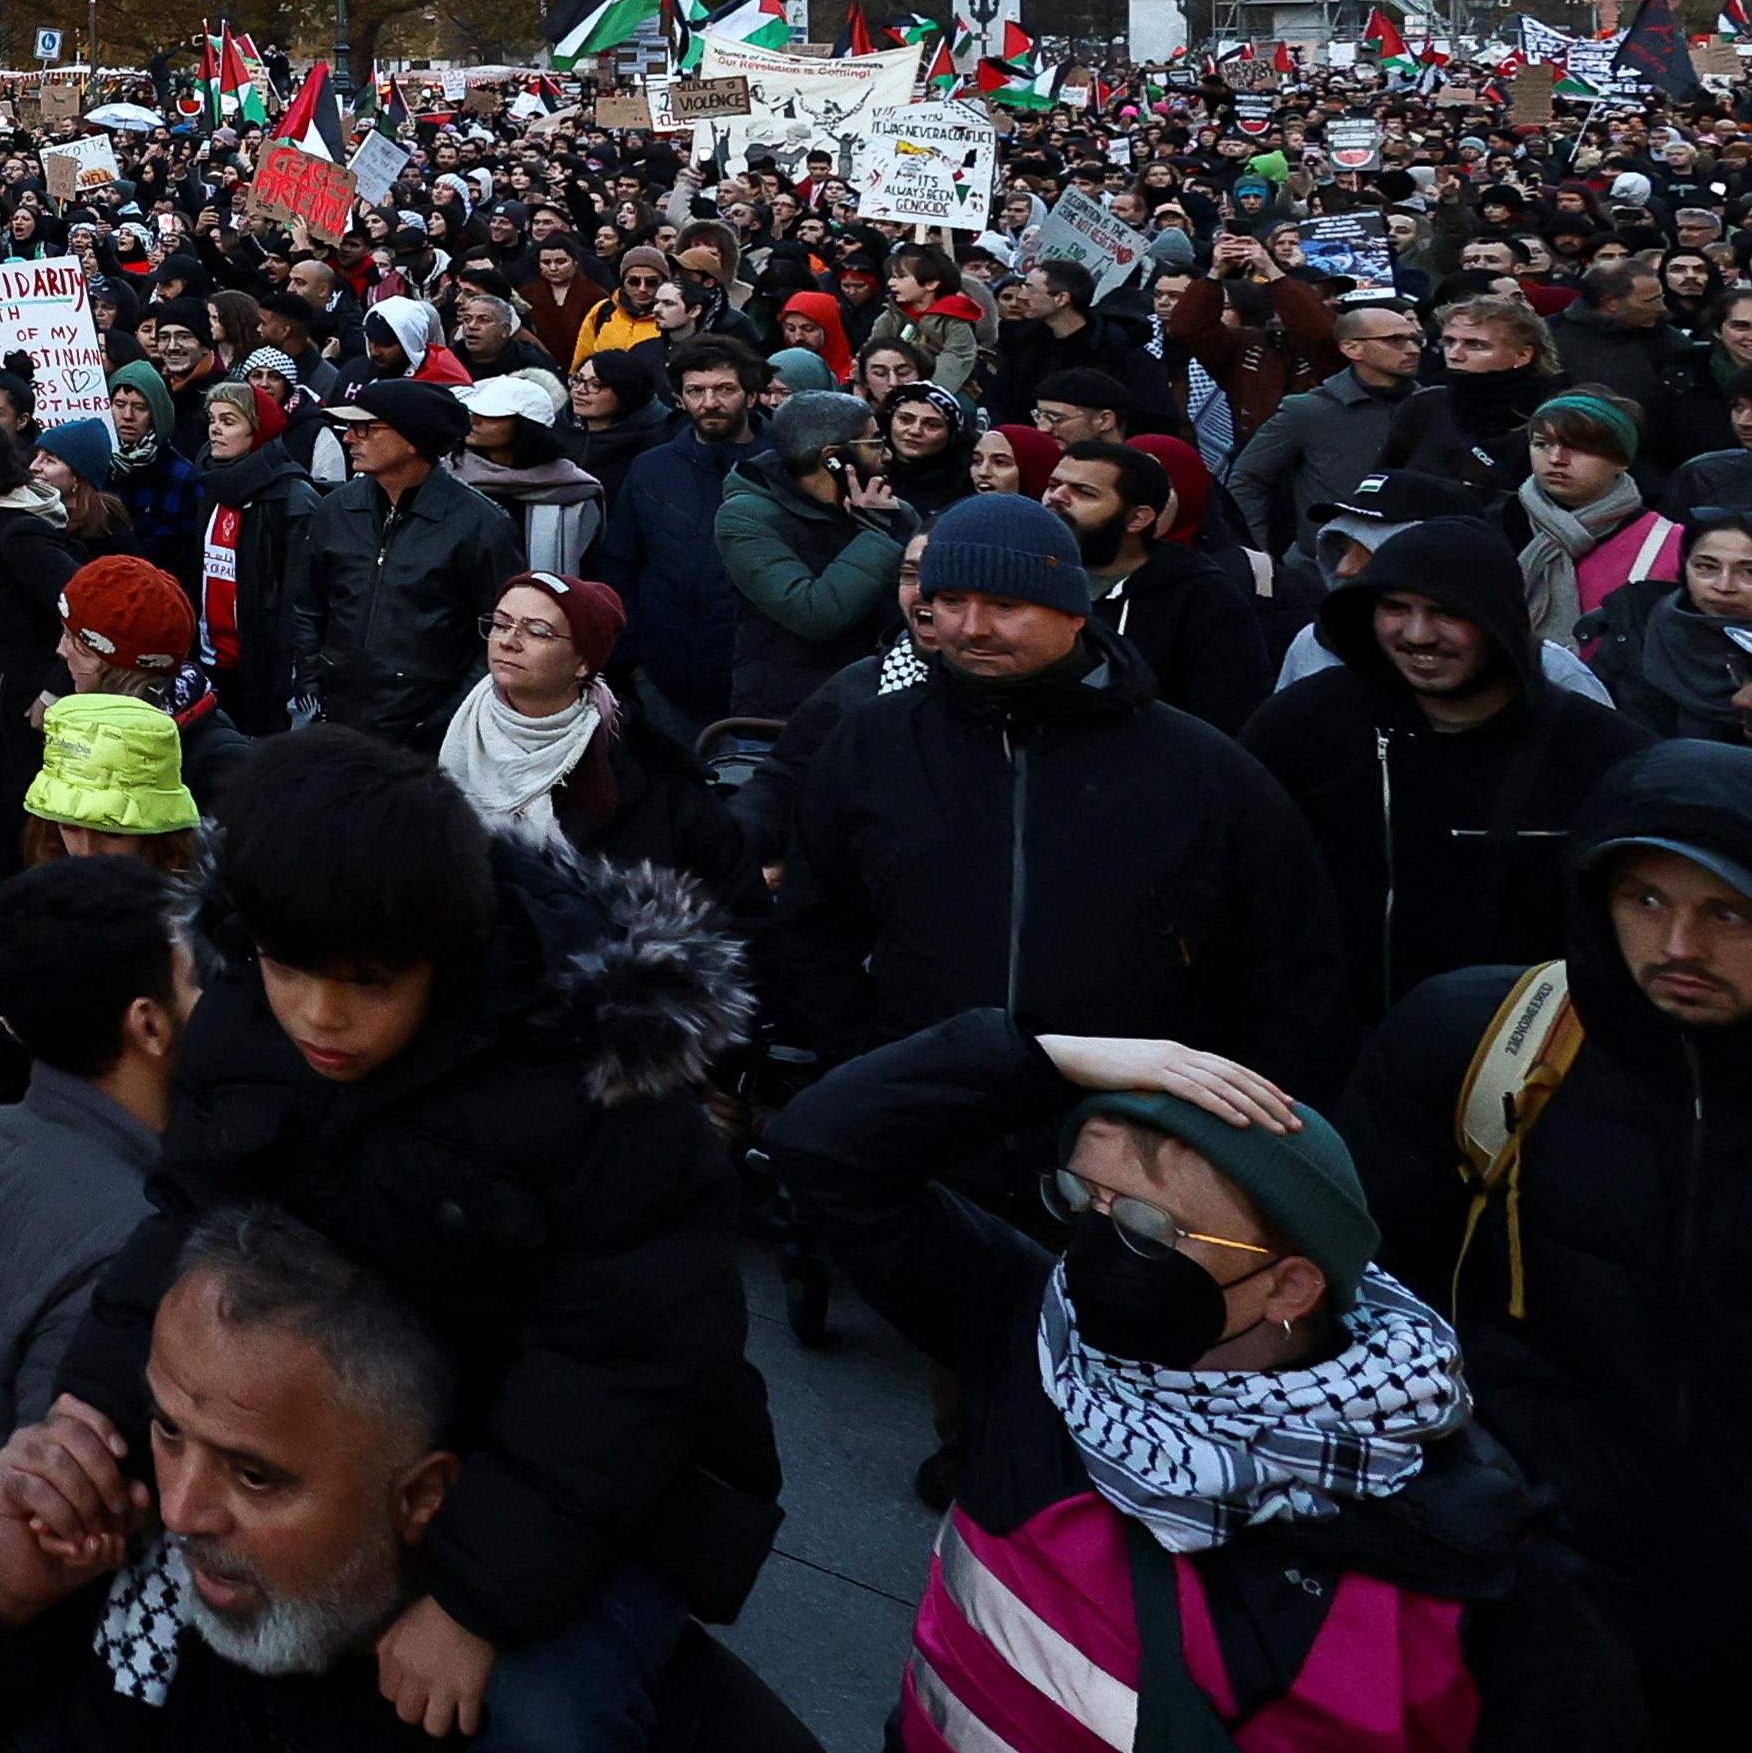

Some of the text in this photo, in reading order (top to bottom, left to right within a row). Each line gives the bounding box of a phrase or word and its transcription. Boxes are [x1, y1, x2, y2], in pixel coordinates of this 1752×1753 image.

[718, 56, 737, 67] Our
[739, 59, 800, 74] Revolution
[817, 66, 872, 80] Coming!
[676, 81, 717, 93] SILENCE
[679, 92, 746, 112] VIOLENCE
[871, 121, 881, 134] IT
[905, 125, 937, 140] NEVER
[948, 129, 994, 145] CONFLICT
[884, 185, 954, 202] ALWAYS BEEN
[895, 198, 950, 214] GENOCIDE
[16, 327, 39, 342] OF
[51, 325, 78, 345] MY
